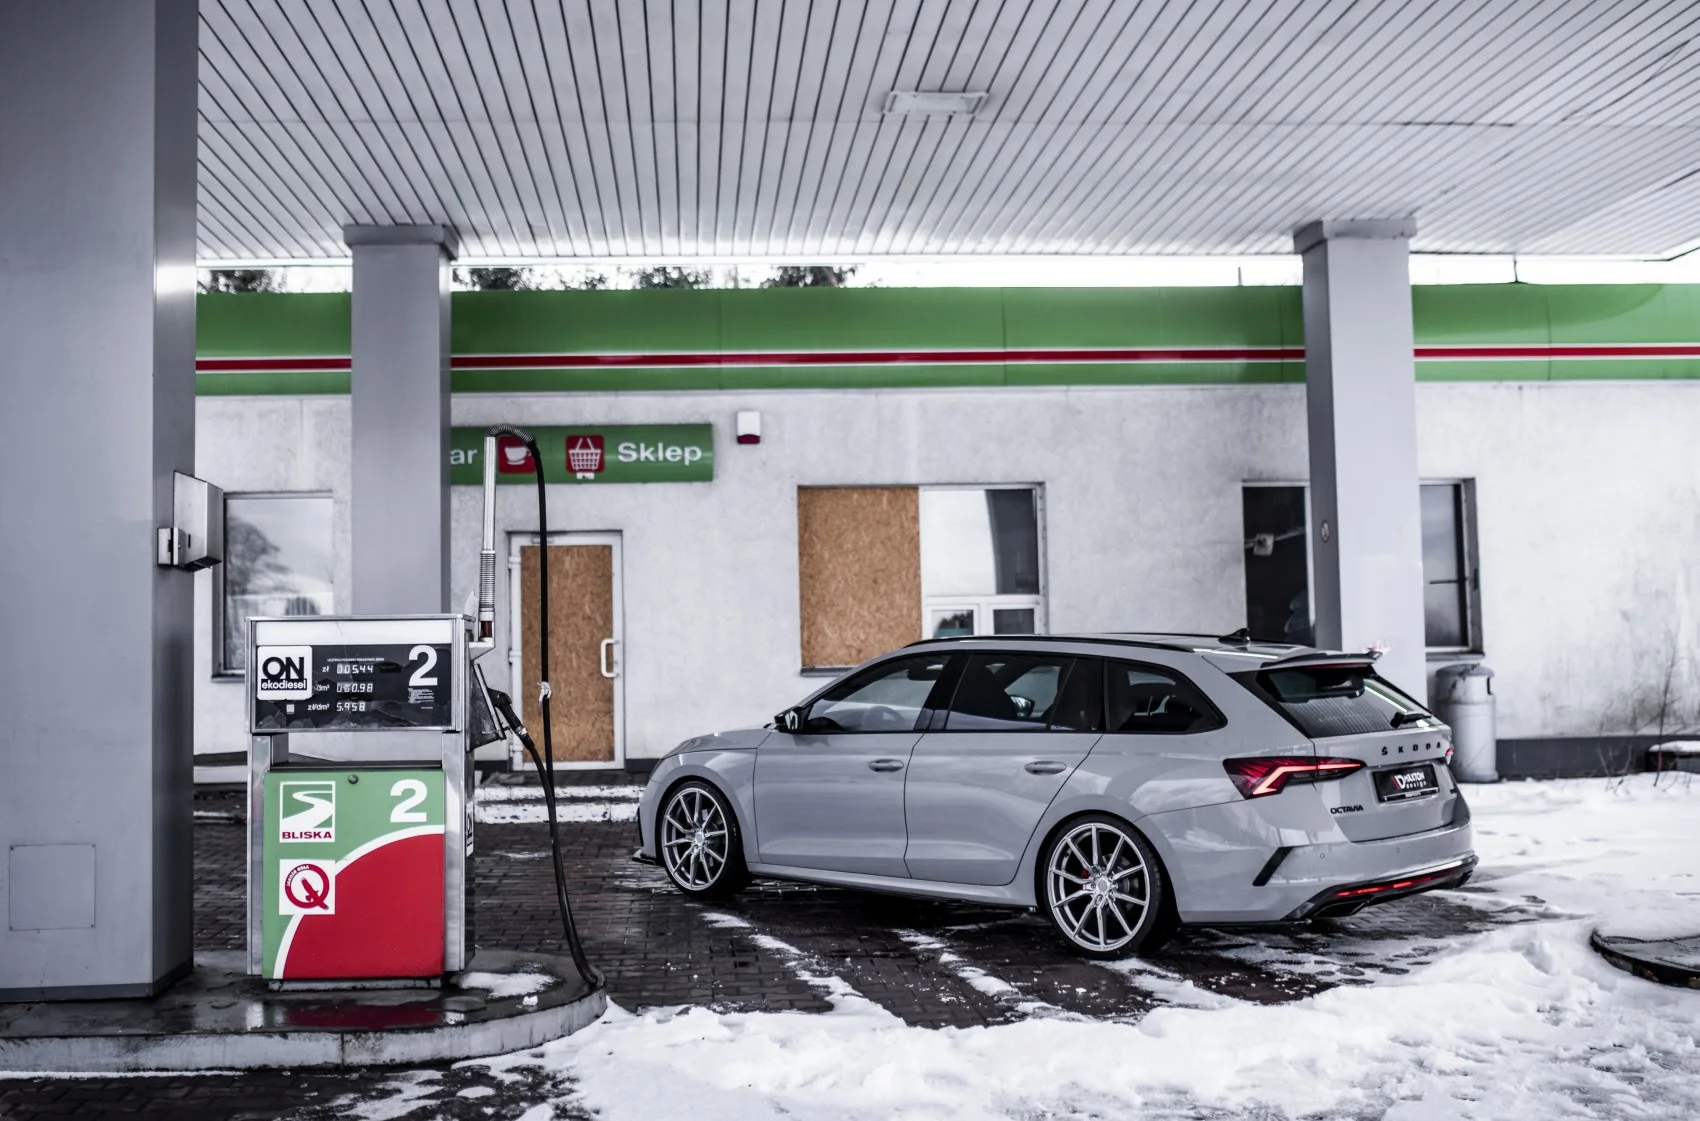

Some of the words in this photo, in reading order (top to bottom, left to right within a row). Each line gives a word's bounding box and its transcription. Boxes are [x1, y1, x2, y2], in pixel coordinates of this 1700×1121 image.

[450, 448, 478, 465] ar
[617, 442, 703, 466] Sklep
[262, 656, 305, 680] ON
[408, 644, 438, 687] 2
[261, 679, 307, 690] ekodiesel
[390, 779, 428, 823] 2
[1330, 804, 1364, 815] OCTAVIA
[282, 831, 333, 840] BLISKA
